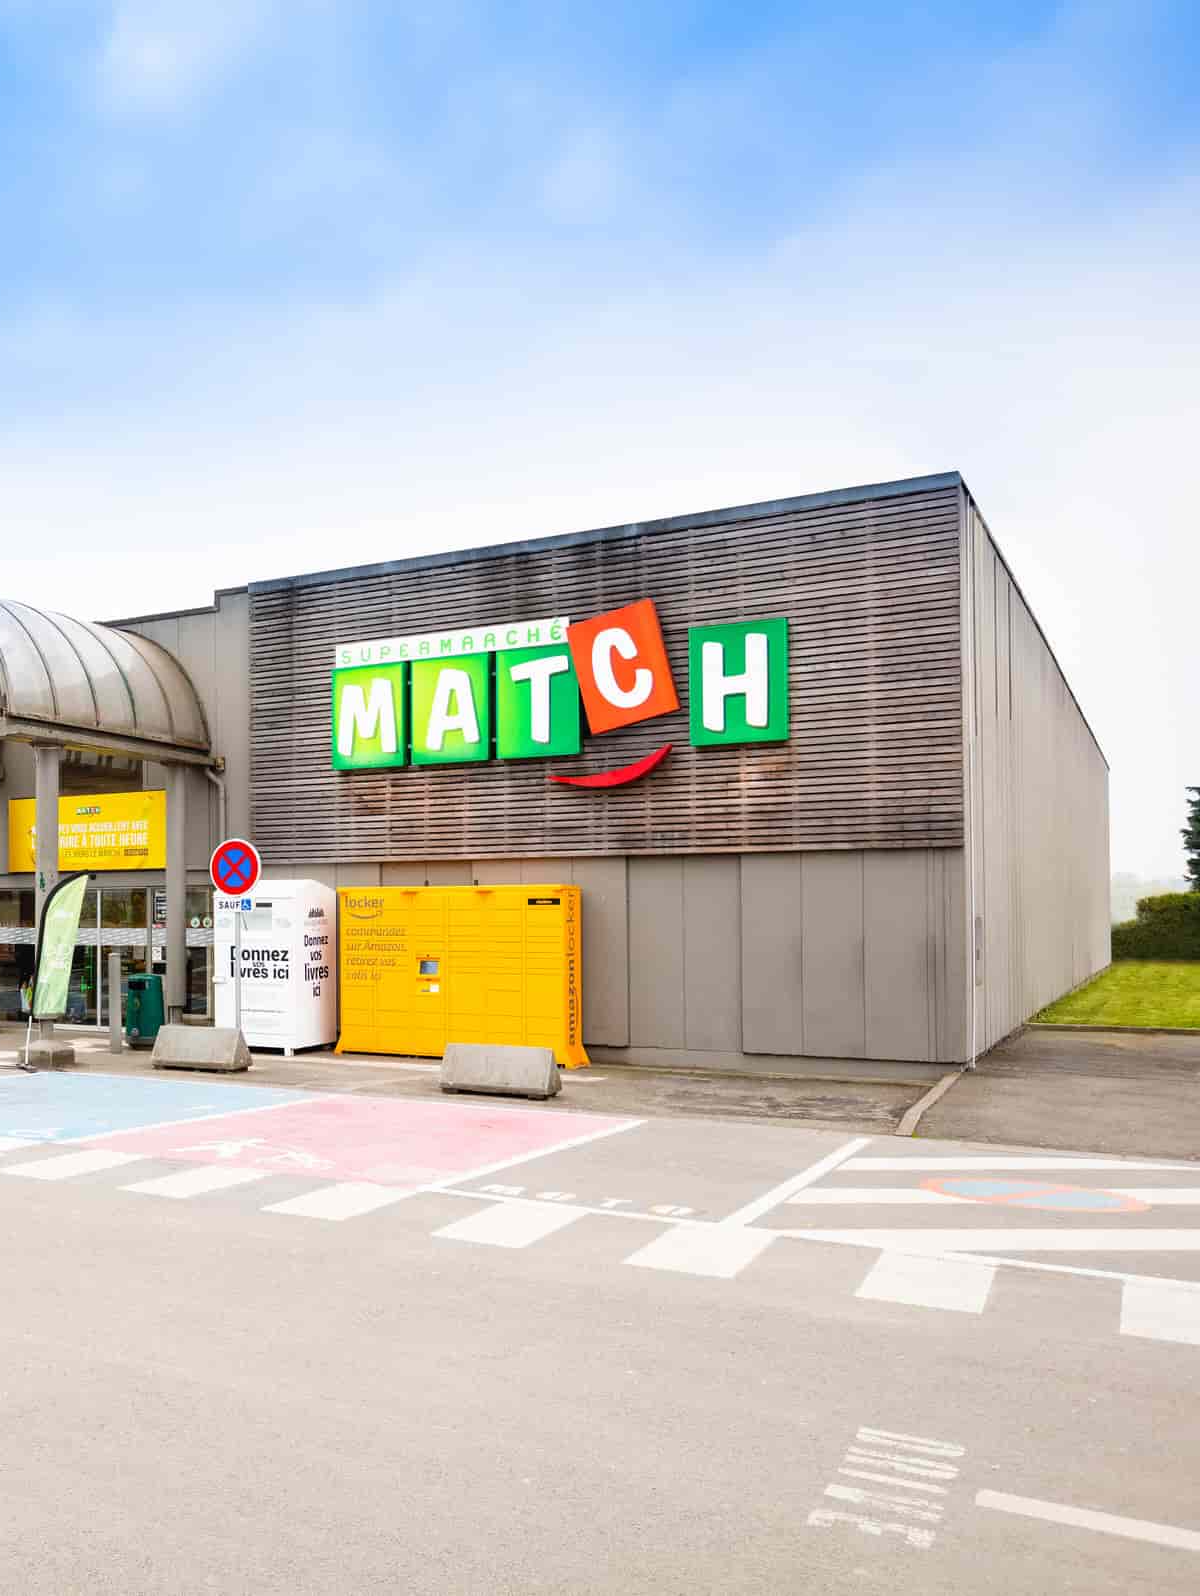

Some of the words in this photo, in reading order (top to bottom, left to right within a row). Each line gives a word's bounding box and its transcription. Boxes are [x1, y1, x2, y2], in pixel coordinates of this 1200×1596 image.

[341, 617, 564, 665] SUPERMARCHÉ
[337, 627, 769, 756] MATCH
[218, 901, 241, 909] SAUF
[303, 934, 329, 947] Donnez
[310, 951, 323, 961] vos
[230, 961, 269, 978] lvres
[273, 964, 289, 980] ici
[304, 964, 329, 982] livres
[312, 983, 321, 998] ici
